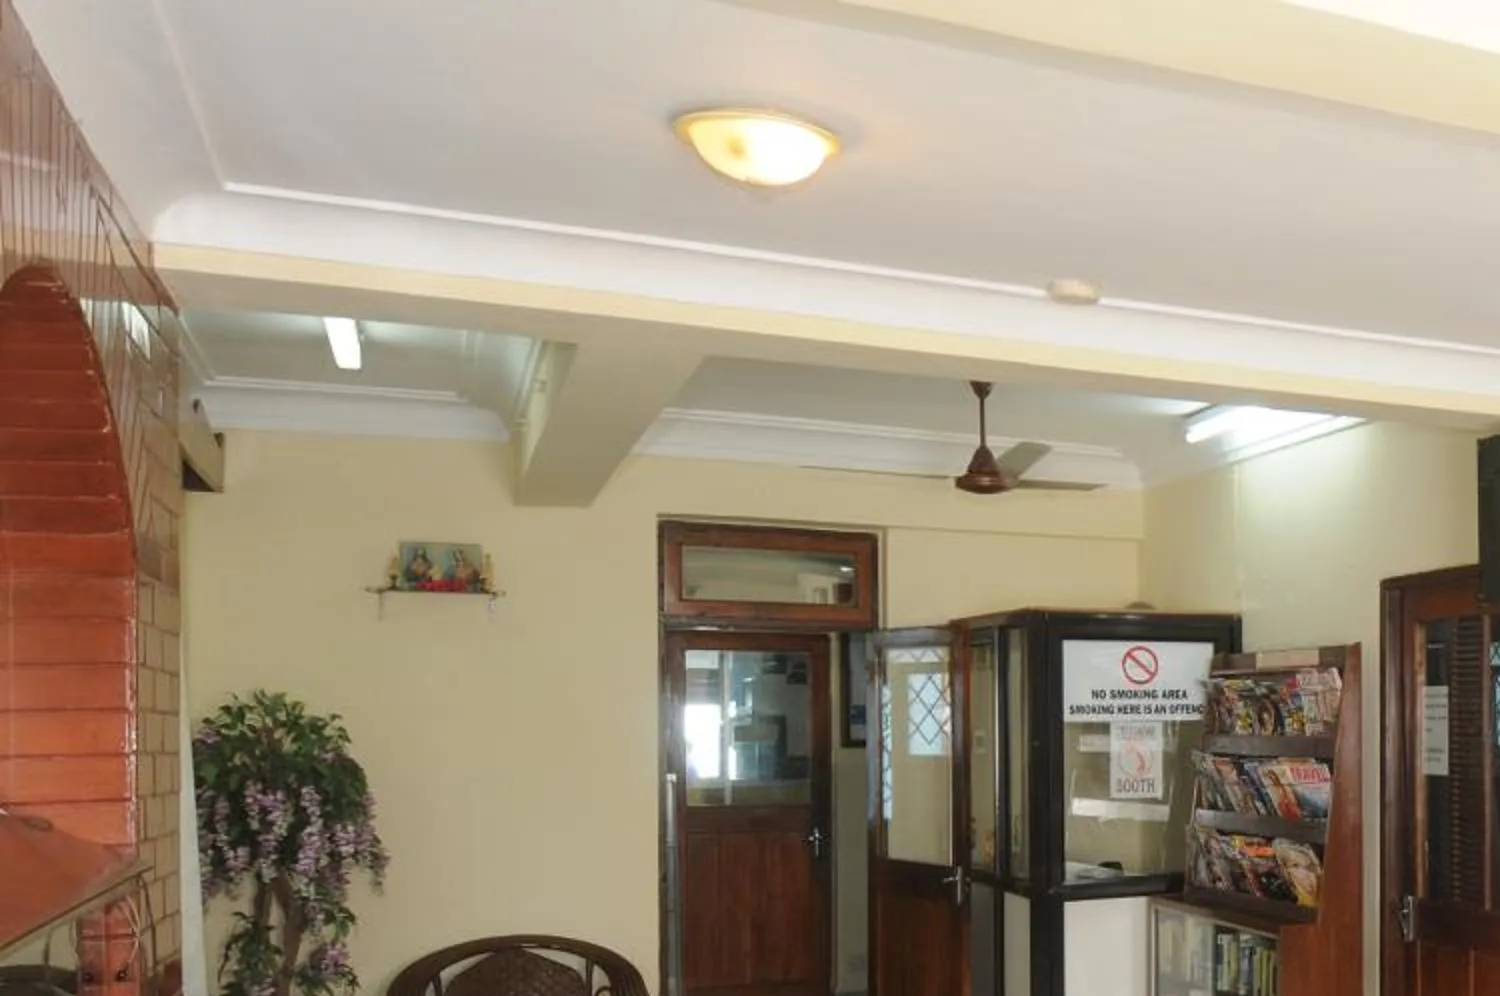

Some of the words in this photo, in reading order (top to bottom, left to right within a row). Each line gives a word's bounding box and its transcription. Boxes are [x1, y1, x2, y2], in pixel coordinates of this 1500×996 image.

[1091, 689, 1107, 700] NO
[1110, 689, 1159, 700] SMOKING
[1161, 689, 1188, 700] AREA
[1069, 704, 1115, 715] SMOKING
[1117, 704, 1141, 715] HERE
[1143, 704, 1153, 715] IS
[1154, 704, 1167, 715] AN
[1116, 777, 1155, 793] BOOTH
